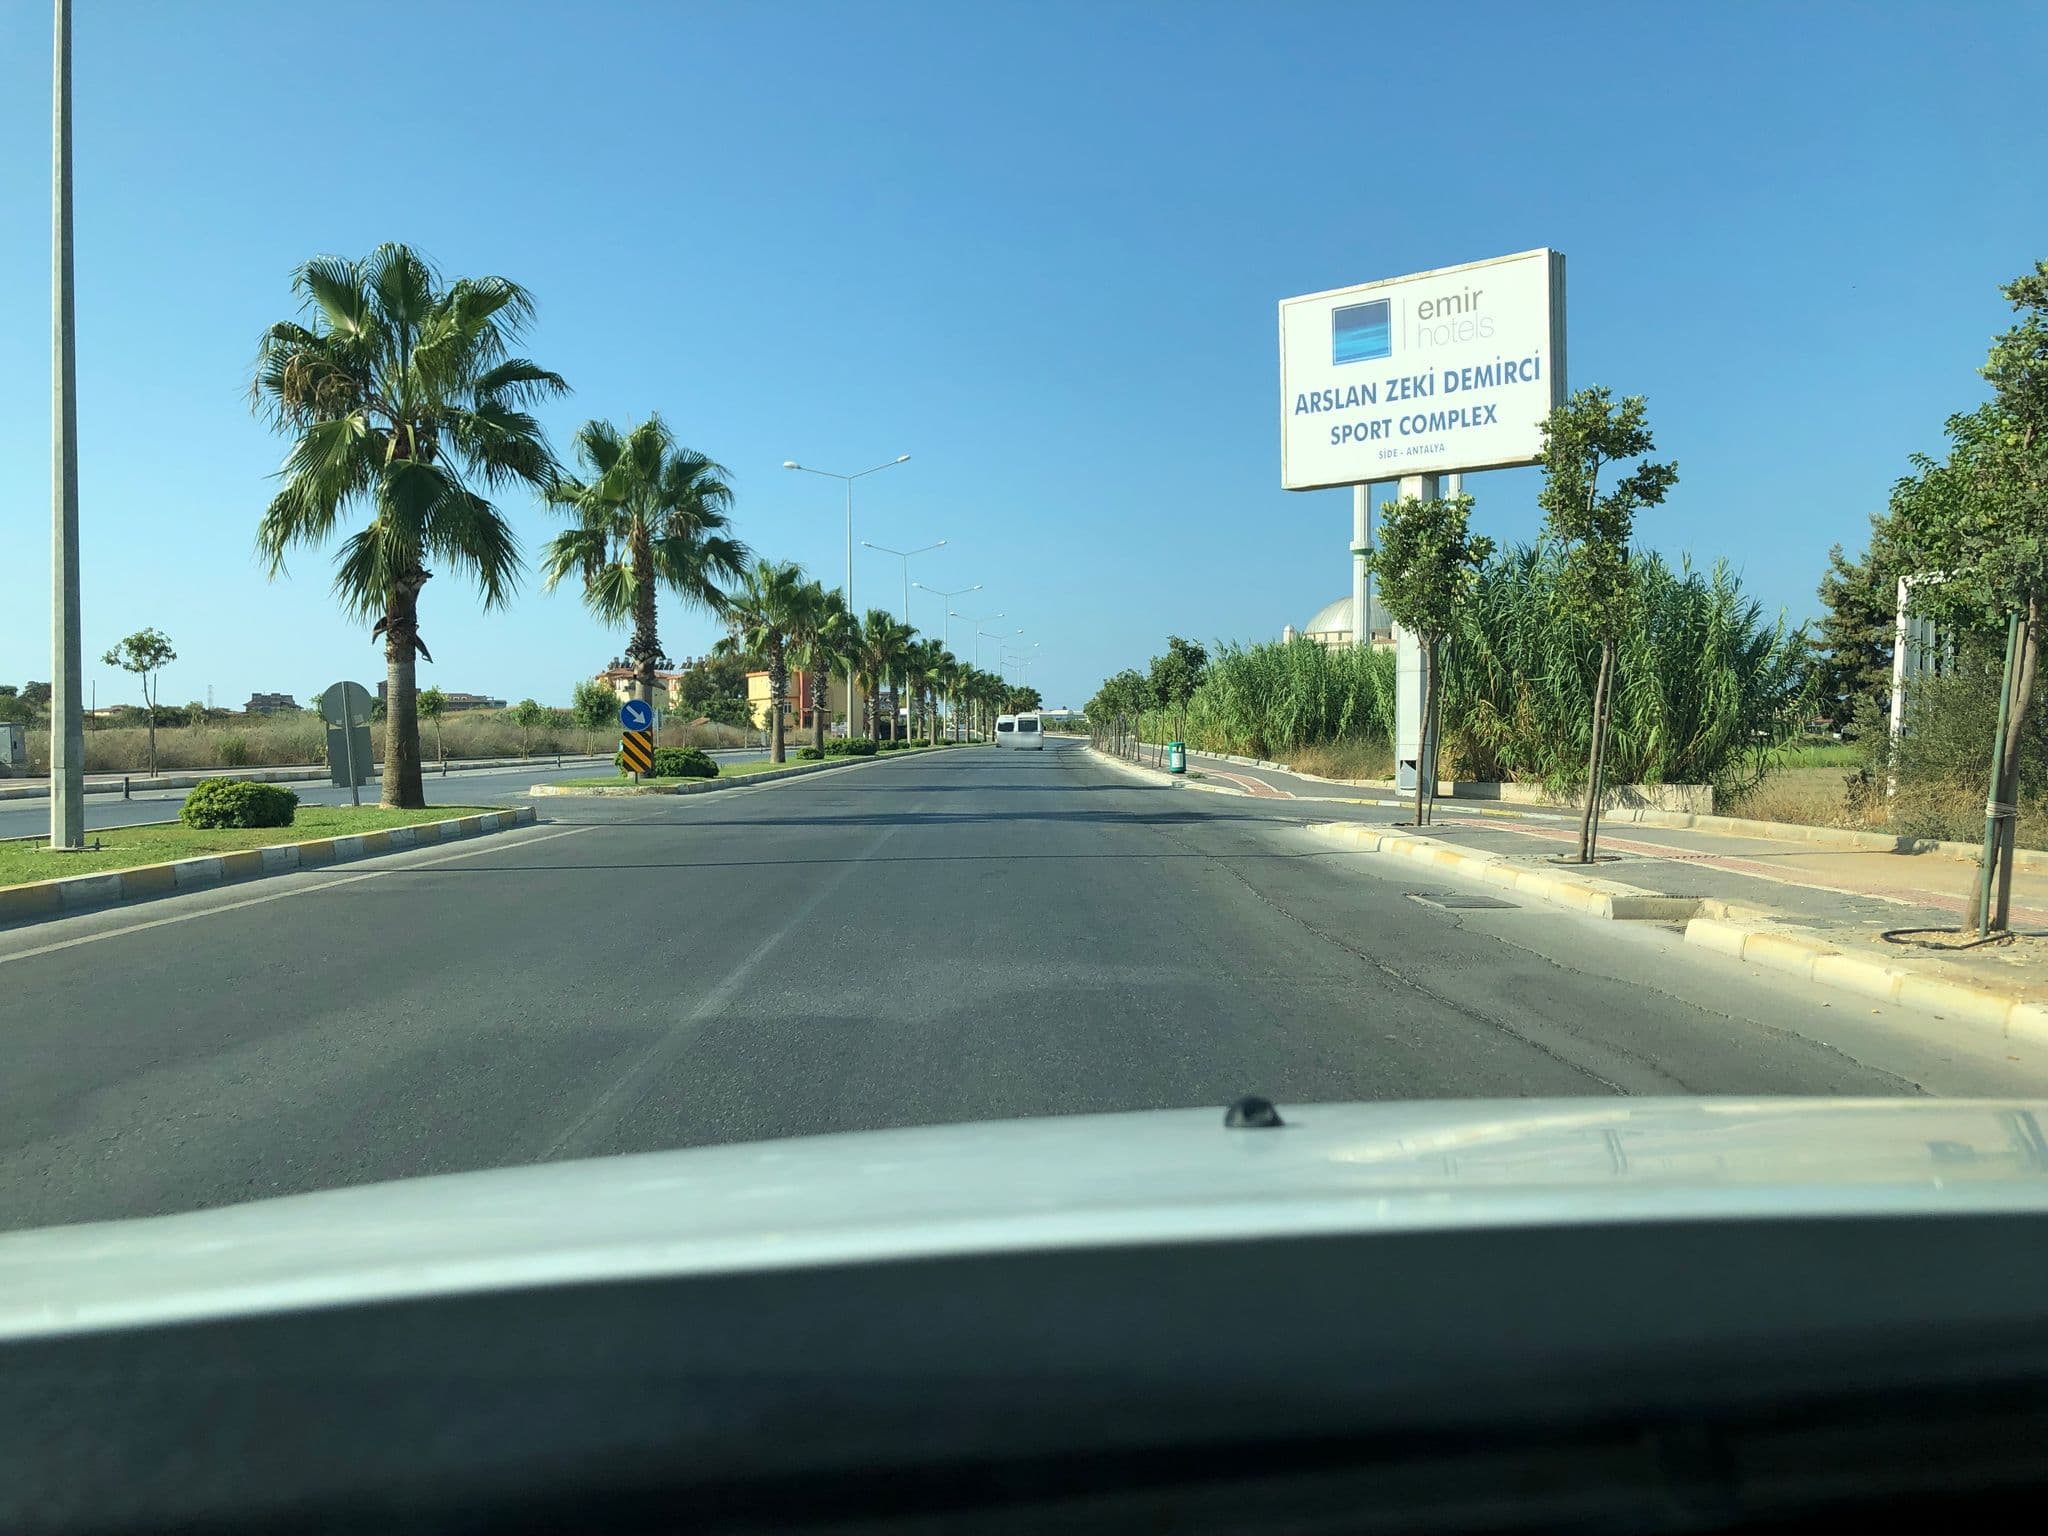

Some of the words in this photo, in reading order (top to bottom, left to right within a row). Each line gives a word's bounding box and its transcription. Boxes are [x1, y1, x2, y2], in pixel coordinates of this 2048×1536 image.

[1418, 286, 1483, 320] emir
[1418, 314, 1494, 349] hotels
[1295, 382, 1377, 415] ARSLAN
[1385, 366, 1434, 402] ZEKİ
[1444, 350, 1541, 393] DEMİRCİ
[1331, 419, 1392, 445] SPORT
[1399, 404, 1497, 436] COMPLEX
[1406, 443, 1445, 456] ANTALYA
